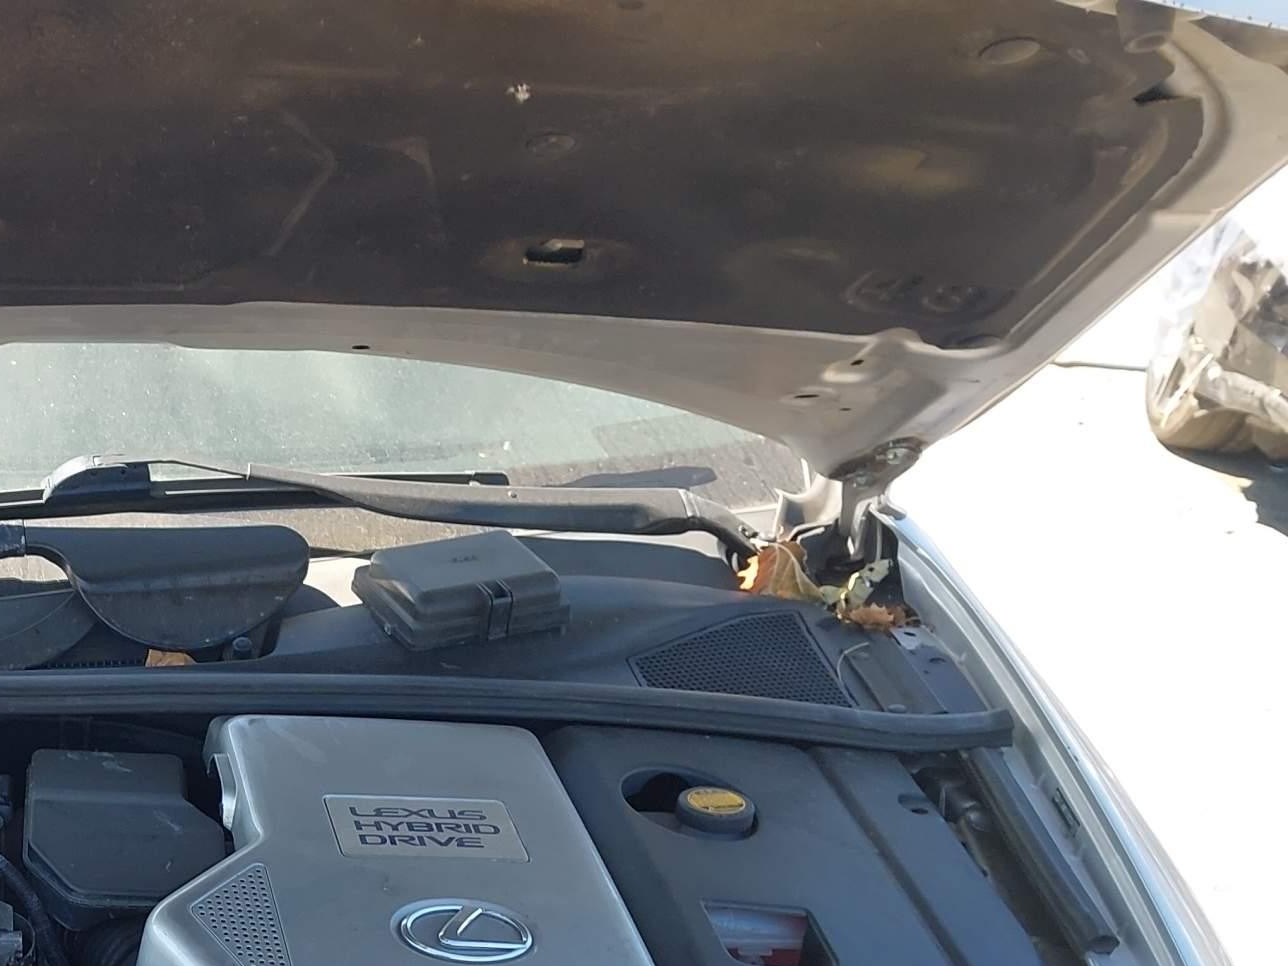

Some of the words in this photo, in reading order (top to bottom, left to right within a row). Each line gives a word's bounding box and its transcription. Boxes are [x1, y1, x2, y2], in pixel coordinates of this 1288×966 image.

[349, 806, 488, 821] LEXUS
[355, 821, 501, 836] HYBRID
[360, 835, 485, 849] DRIVE
